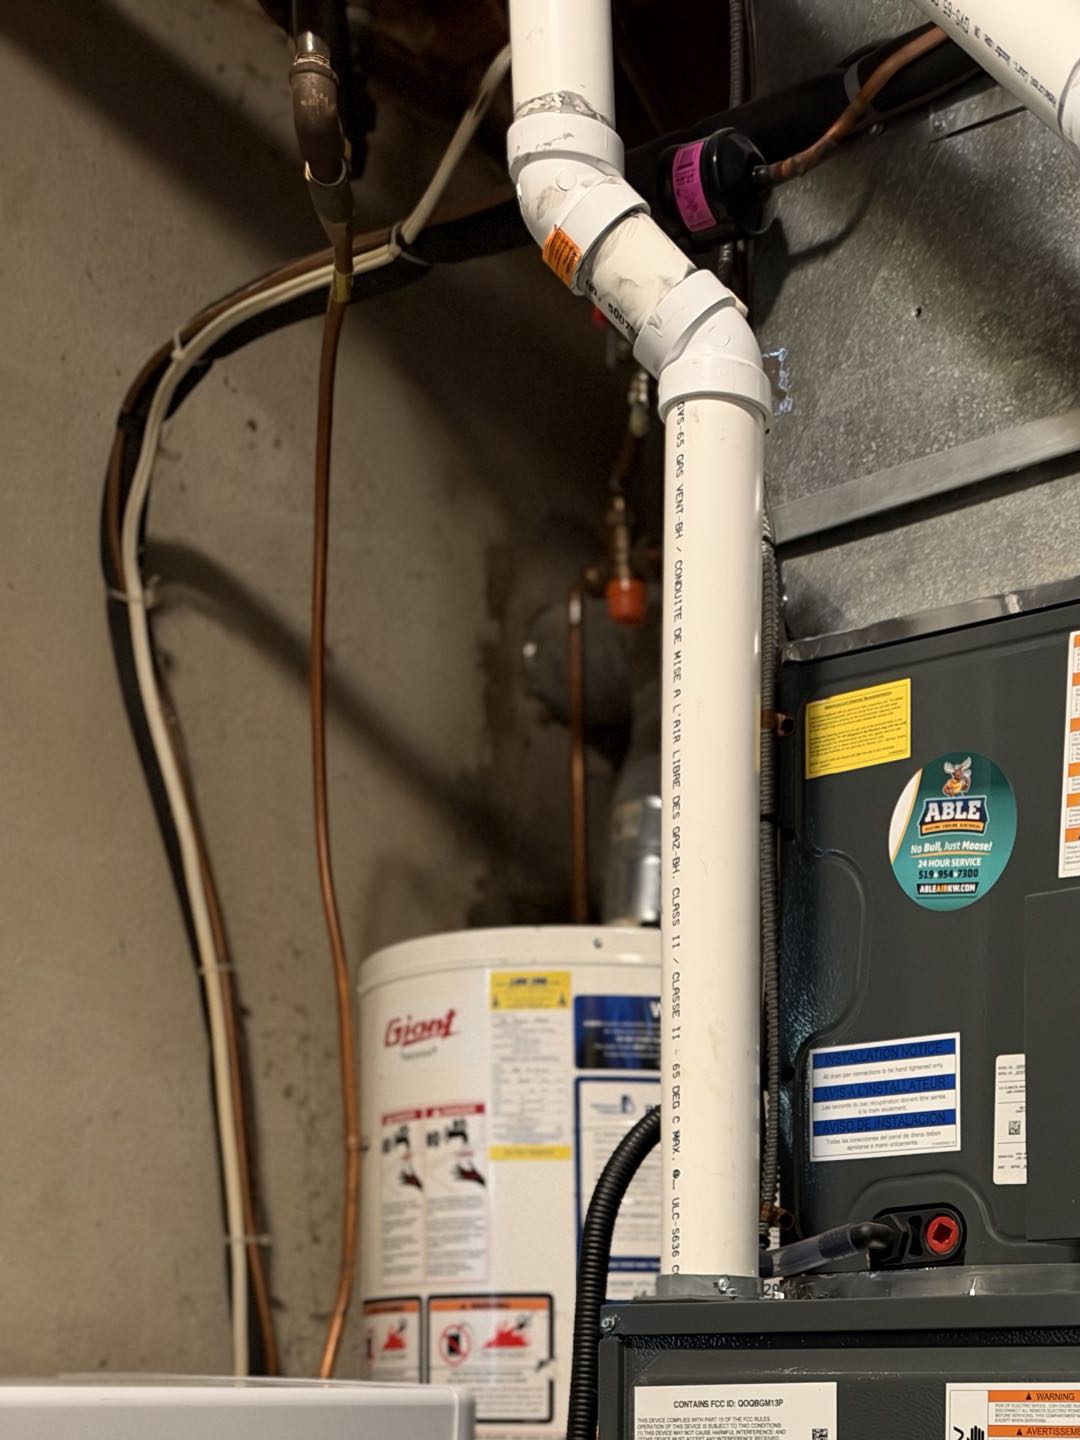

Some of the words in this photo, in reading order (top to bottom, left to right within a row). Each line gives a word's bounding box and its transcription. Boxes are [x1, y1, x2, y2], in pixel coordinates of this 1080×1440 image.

[675, 454, 685, 479] GAS
[674, 483, 685, 540] VENT-BH
[673, 559, 684, 622] CONDUITE
[673, 628, 683, 645] DE
[672, 650, 683, 683] MISE
[672, 689, 682, 700] A
[672, 749, 681, 789] LIBRE
[671, 795, 681, 820] DES
[925, 800, 982, 823] ABLE
[911, 844, 923, 855] No
[923, 842, 943, 854] Bull,
[944, 841, 961, 851] Just
[962, 840, 993, 851] Moose!
[918, 859, 928, 869] 24
[928, 858, 951, 868] HOUR
[951, 857, 982, 867] SERVICE
[671, 887, 681, 927] CLASS
[671, 971, 681, 1019] CLASSE
[824, 1045, 899, 1065] INSTALLATION
[902, 1042, 944, 1055] NOTICE
[671, 1063, 681, 1079] 65
[671, 1085, 681, 1110] DEG
[671, 1115, 681, 1125] C
[823, 1119, 855, 1133] AVISO
[856, 1117, 871, 1130] DE
[671, 1129, 681, 1161] MAX.
[671, 1197, 681, 1258] ULC-S636
[673, 1399, 710, 1409] CONTAINS
[710, 1399, 726, 1408] FCC
[726, 1399, 737, 1408] ID:
[1036, 1393, 1076, 1401] WARNING
